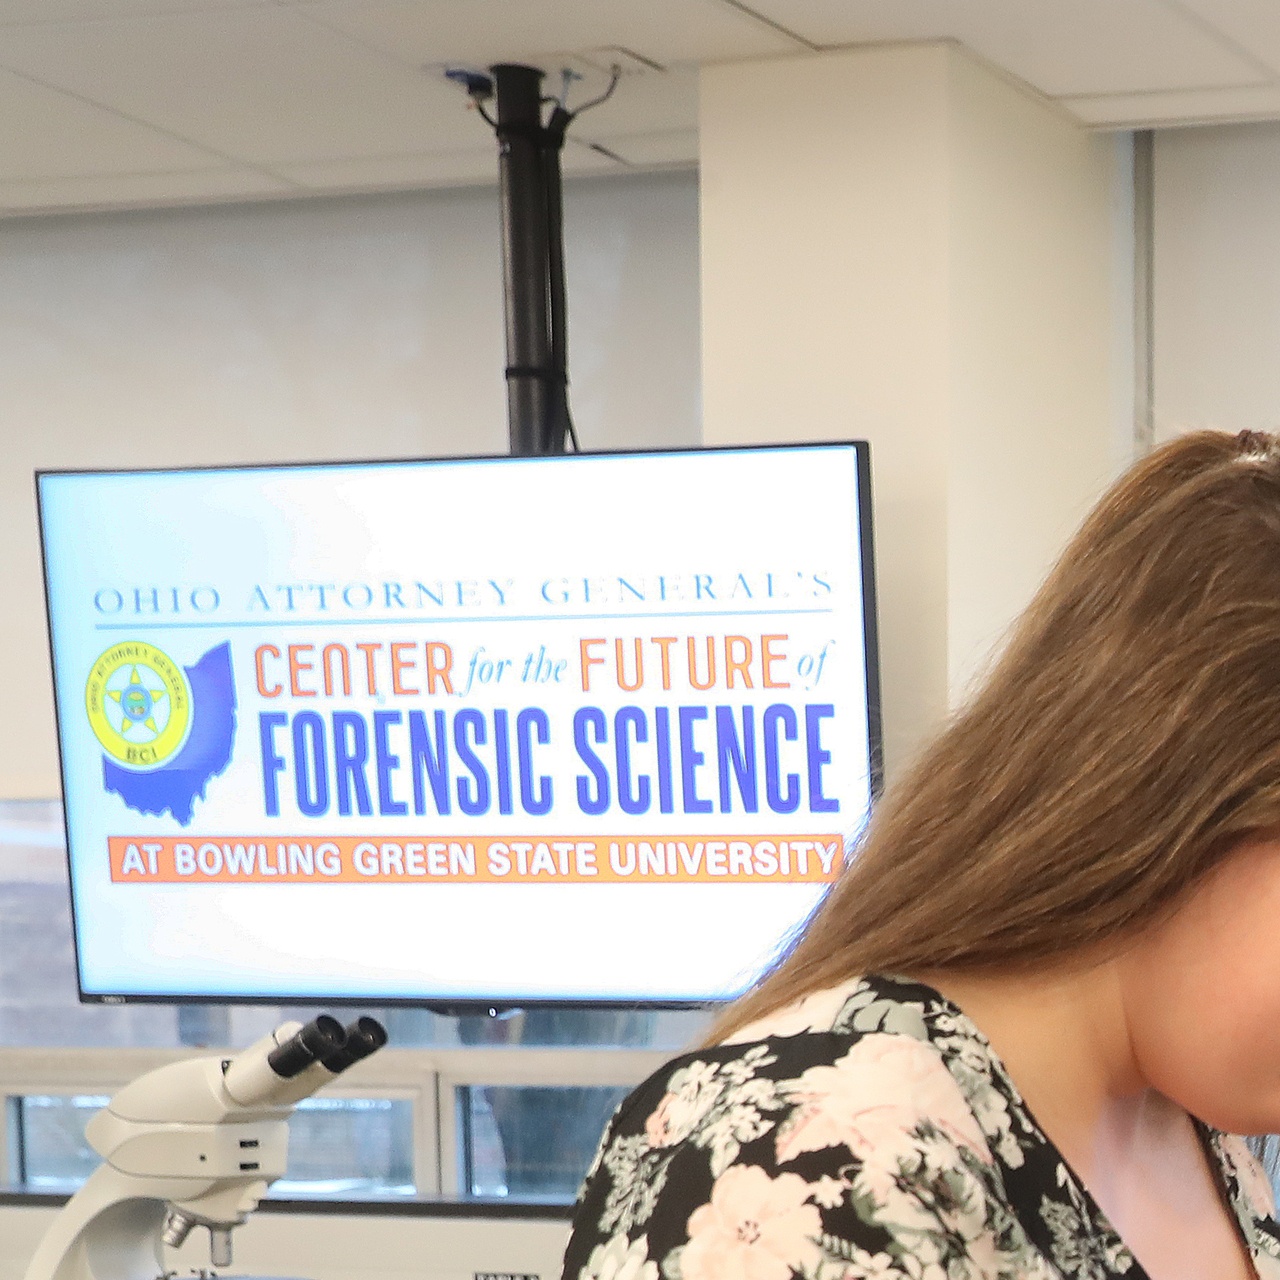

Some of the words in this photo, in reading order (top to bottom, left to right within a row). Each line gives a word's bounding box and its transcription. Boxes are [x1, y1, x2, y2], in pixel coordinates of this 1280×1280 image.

[93, 587, 220, 614] OHIO
[246, 577, 514, 612] ATTORNEY
[541, 571, 834, 604] GENERAL'S
[254, 642, 454, 697] CENTER
[457, 647, 513, 698] for
[520, 645, 567, 684] the
[579, 634, 791, 692] FUTURE
[796, 639, 838, 691] of
[257, 706, 555, 819] FORENSIC
[572, 702, 841, 816] SCIENCE
[121, 842, 163, 876] AT
[174, 842, 342, 876] BOWLING
[352, 841, 476, 876] GREEN
[487, 841, 598, 876] STATE
[610, 840, 838, 876] UNIVERSITY
